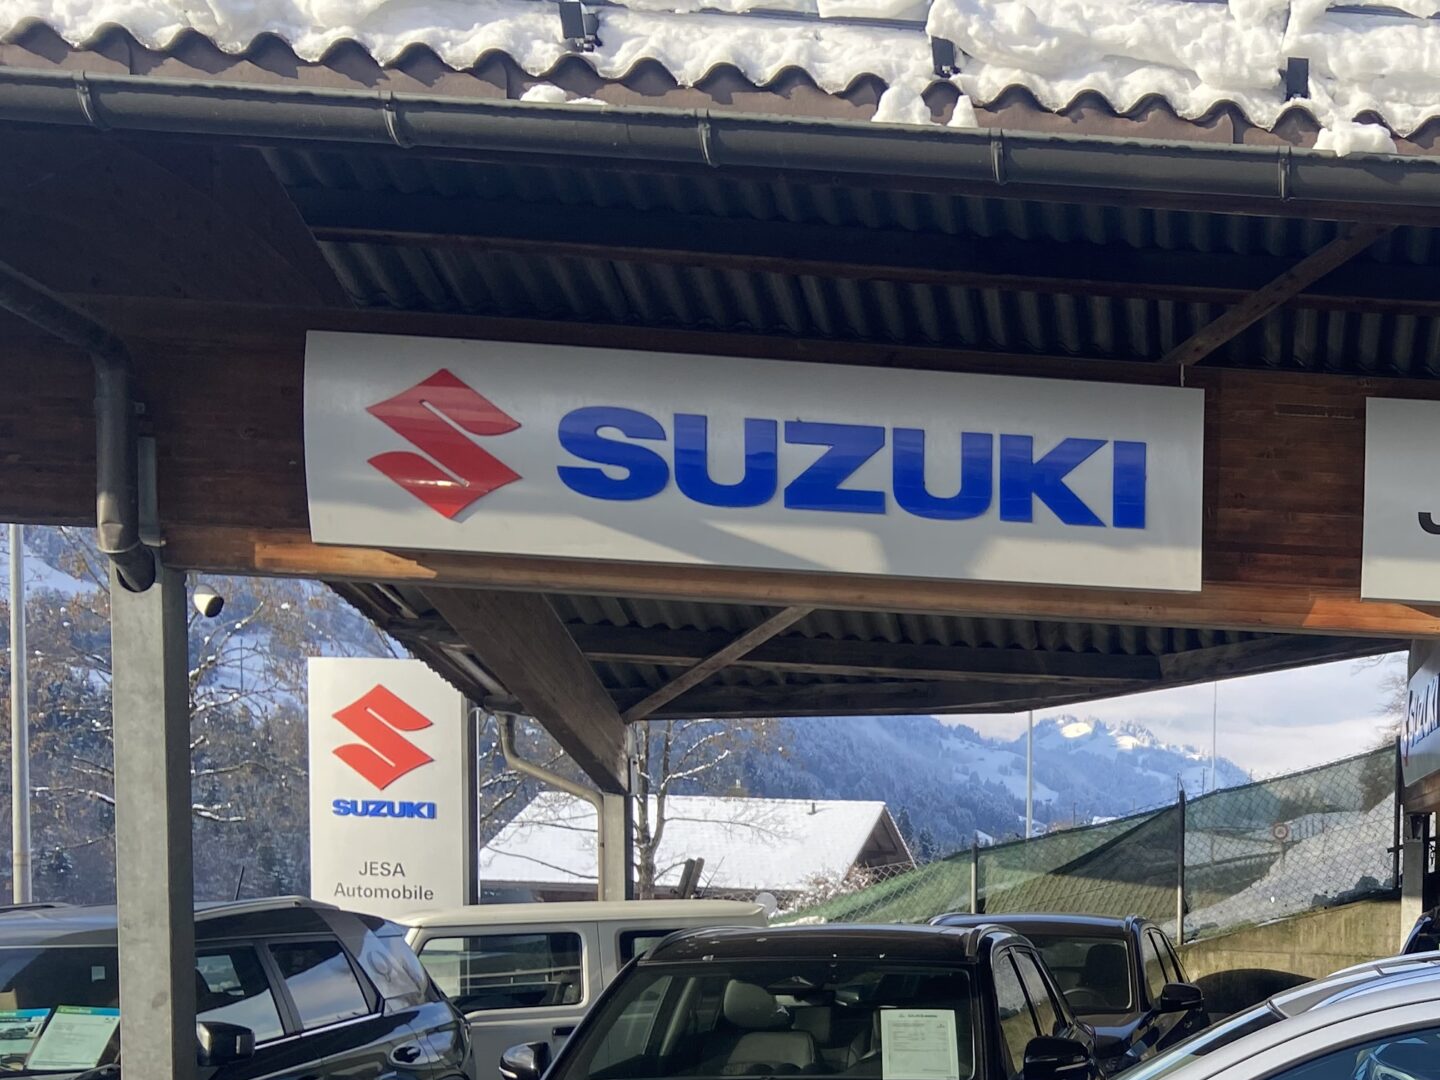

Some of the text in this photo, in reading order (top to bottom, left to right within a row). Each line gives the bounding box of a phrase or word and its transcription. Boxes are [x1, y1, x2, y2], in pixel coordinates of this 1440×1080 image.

[556, 405, 1147, 530] SUZUKI
[332, 799, 437, 819] SUZUKI
[358, 861, 406, 878] JESA
[333, 882, 435, 901] Automobile
